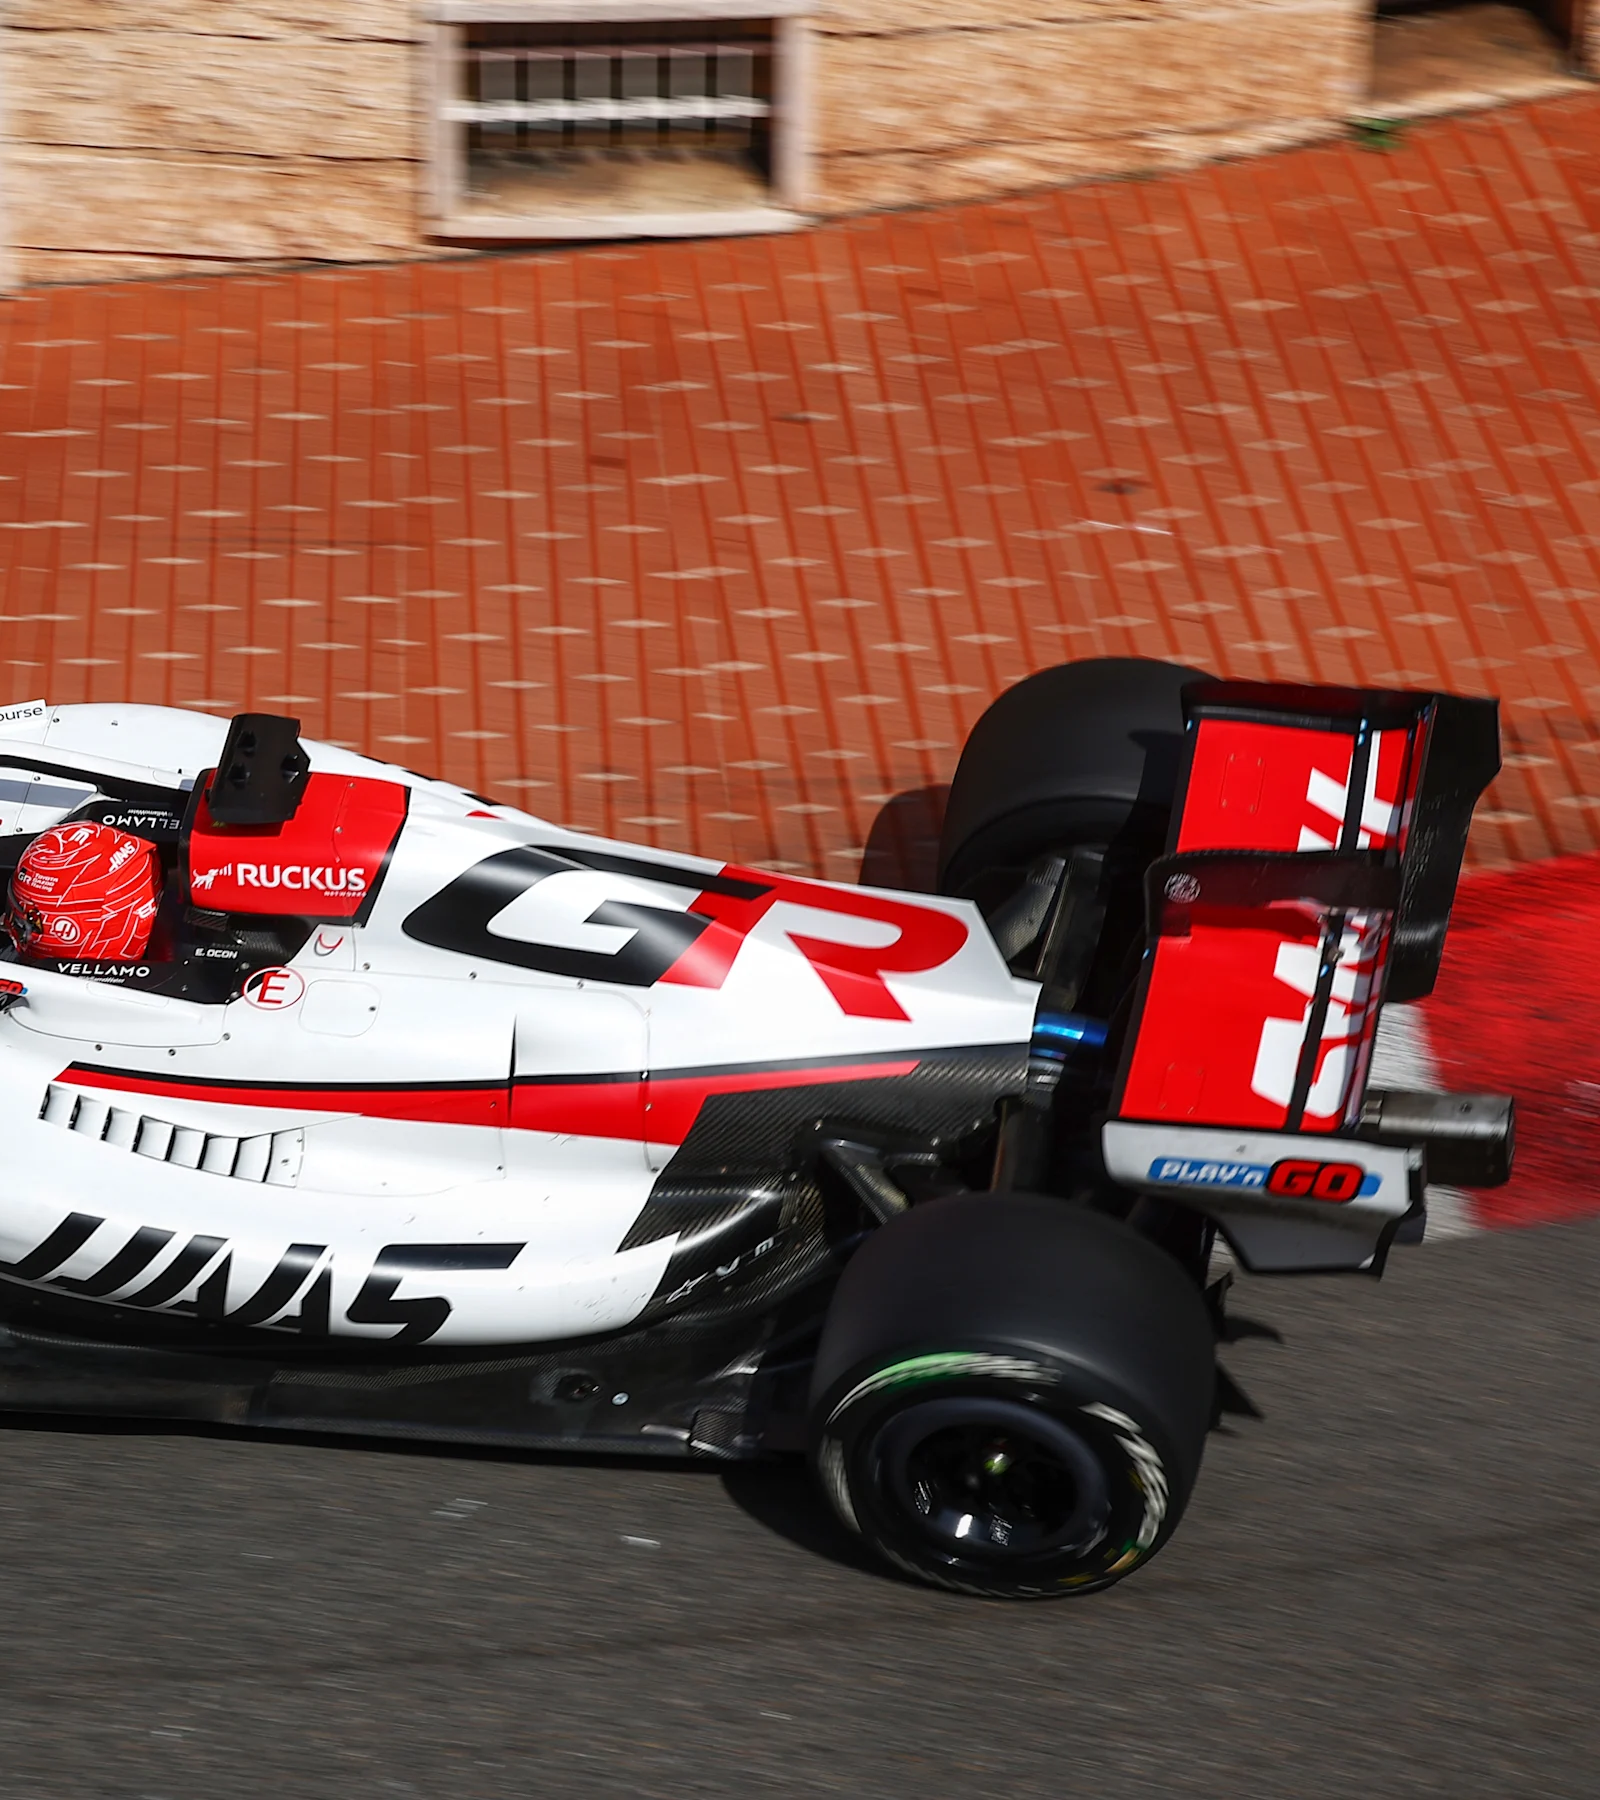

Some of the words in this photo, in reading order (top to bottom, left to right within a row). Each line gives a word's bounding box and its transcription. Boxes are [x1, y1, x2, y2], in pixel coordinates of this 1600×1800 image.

[102, 814, 183, 830] ELLAMO
[108, 841, 136, 873] HAAS
[18, 871, 32, 885] GR
[34, 873, 59, 883] TOYOTA
[236, 862, 367, 892] RUCKUS
[402, 845, 970, 1022] GR
[206, 949, 238, 959] OCON
[57, 963, 151, 978] VELLAMO
[257, 971, 290, 1005] E
[1158, 1160, 1265, 1188] PLAY'n
[1267, 1159, 1365, 1203] GO
[14, 1211, 530, 1345] HAAS
